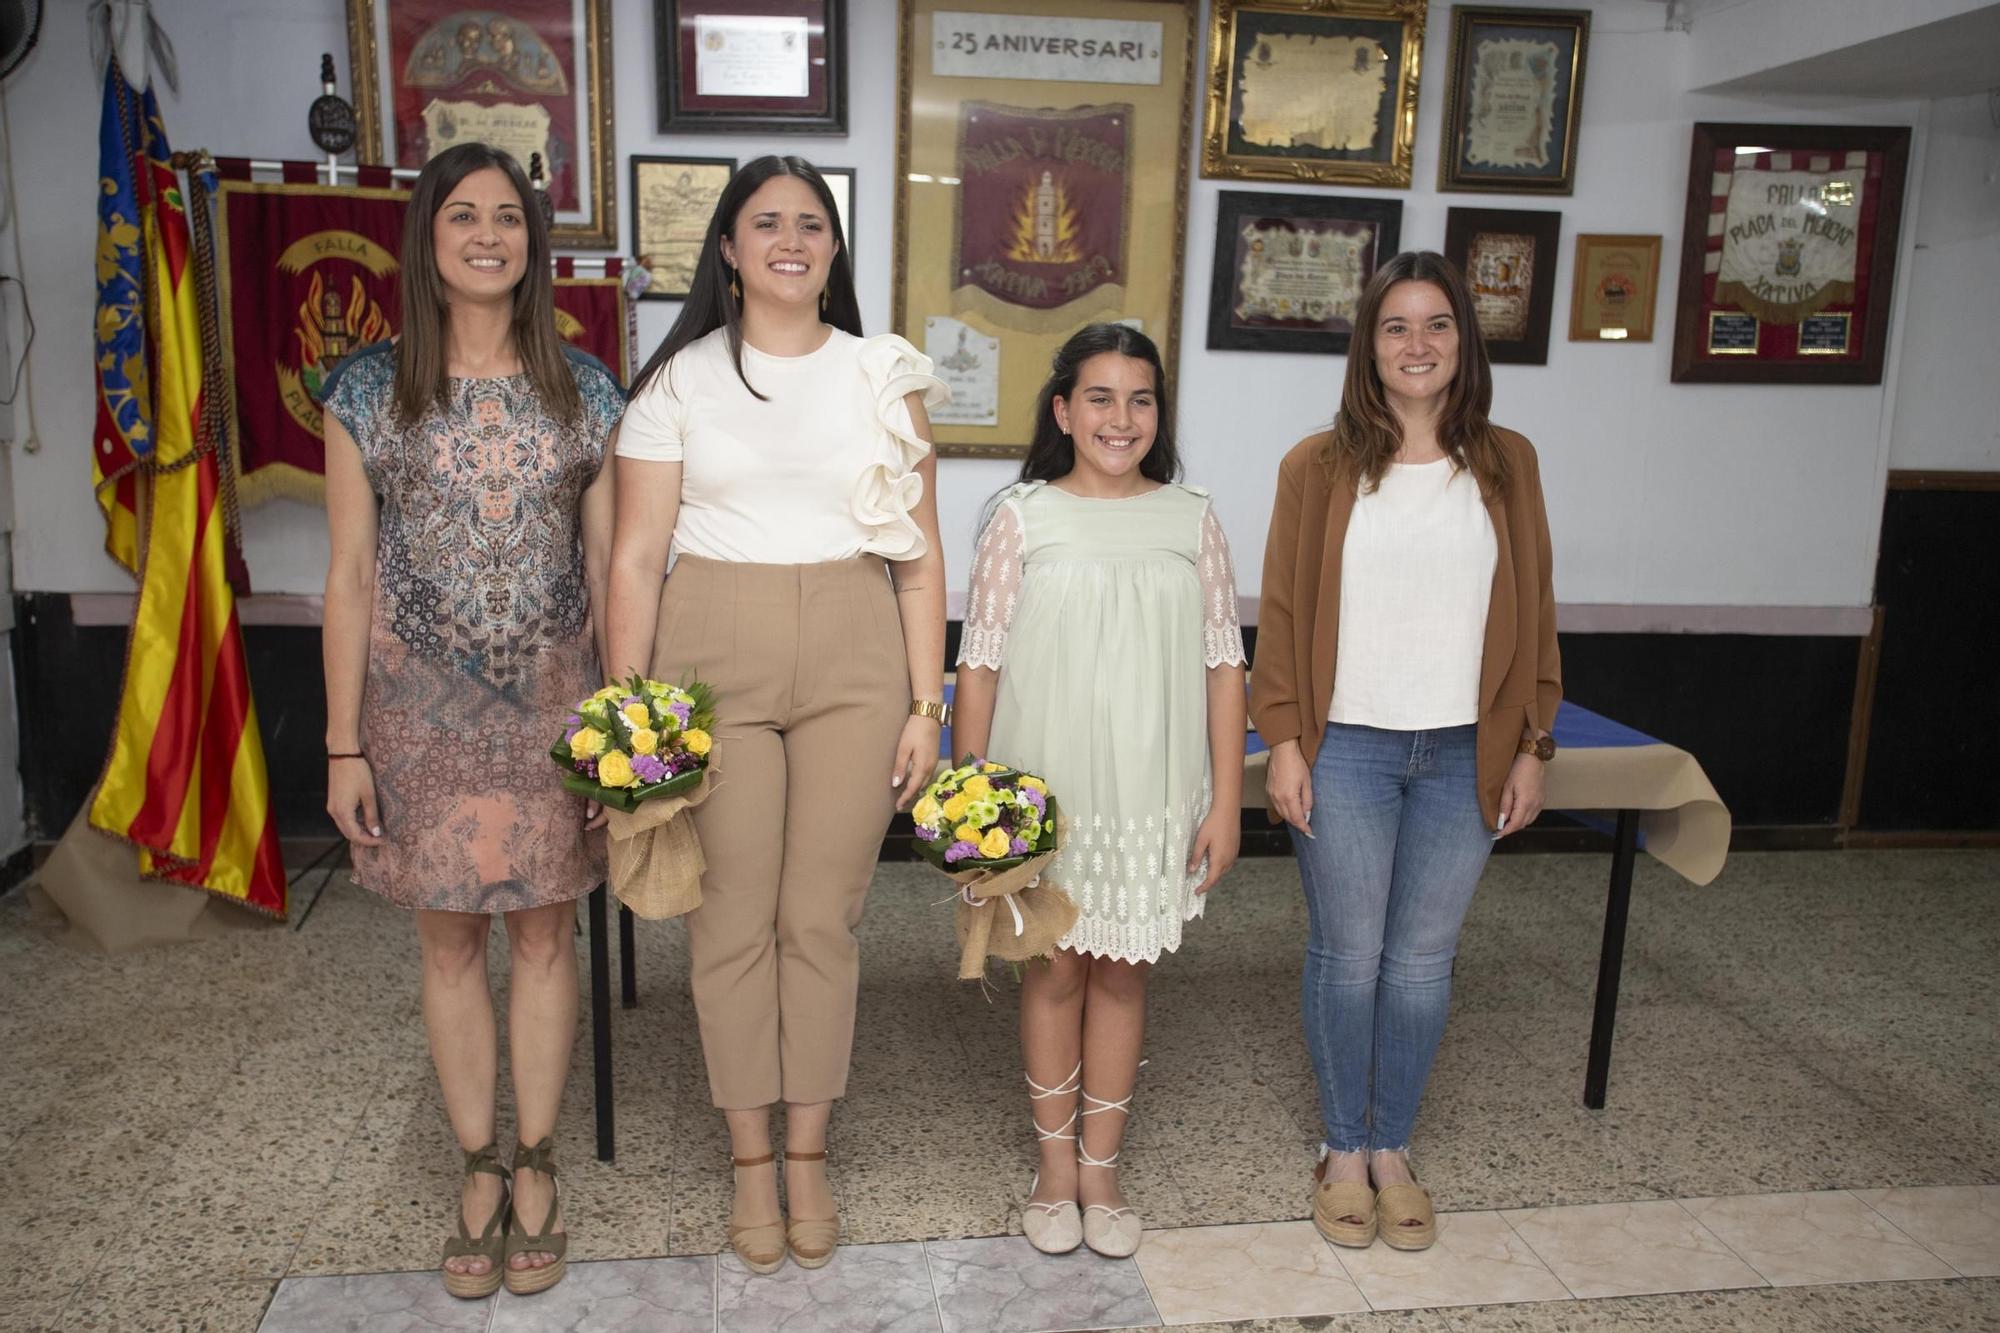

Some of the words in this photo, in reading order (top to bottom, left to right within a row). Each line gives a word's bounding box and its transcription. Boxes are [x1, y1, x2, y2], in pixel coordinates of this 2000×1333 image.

[952, 32, 977, 55] 25
[984, 34, 1143, 61] ANIVERSARI
[1767, 184, 1818, 206] FALLA
[313, 238, 368, 257] FALLA
